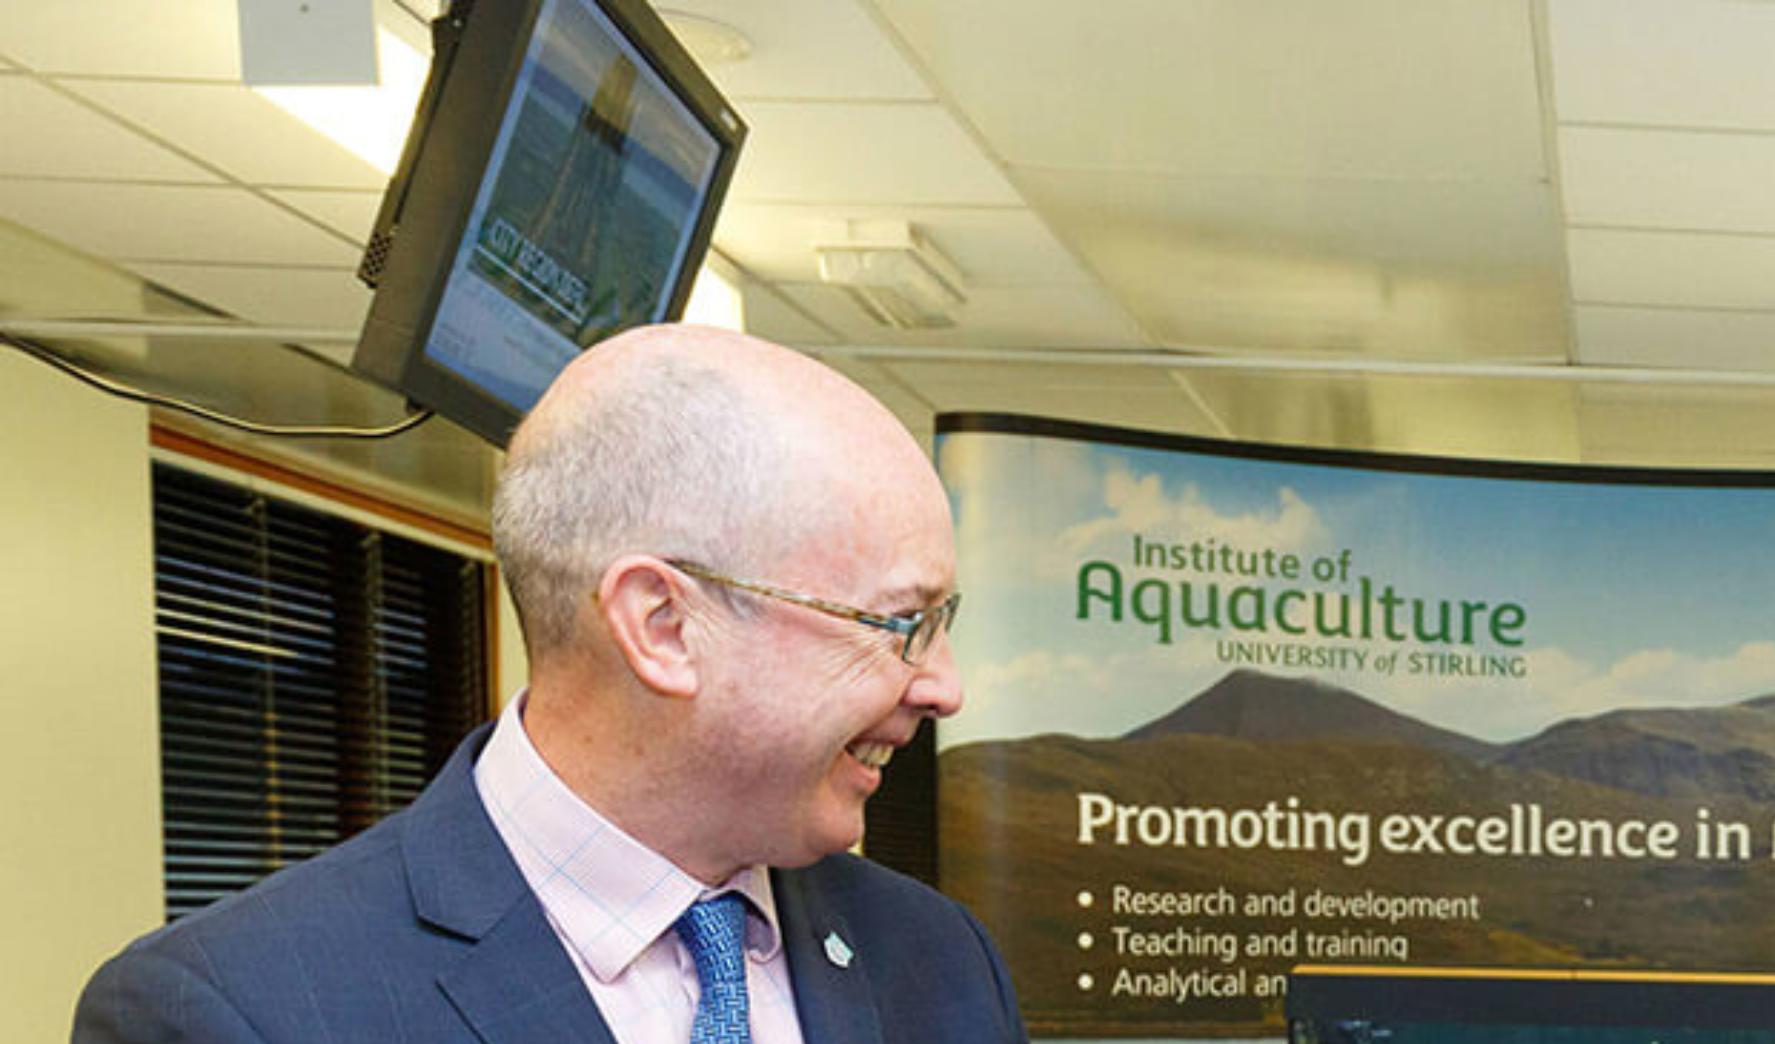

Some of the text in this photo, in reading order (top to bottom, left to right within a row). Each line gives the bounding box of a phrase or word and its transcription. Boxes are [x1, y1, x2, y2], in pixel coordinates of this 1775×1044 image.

[1133, 535, 1352, 582] Institute of
[1076, 561, 1527, 645] Aquaculture
[1215, 639, 1528, 678] UNIVERSITY of STIRLING
[1076, 793, 1371, 866] Promoting
[1380, 804, 1680, 858] excellence
[1697, 808, 1752, 860] in
[1111, 885, 1480, 922] Research and development
[1111, 926, 1408, 962] Teaching and training
[1111, 967, 1289, 1002] Analytical an
